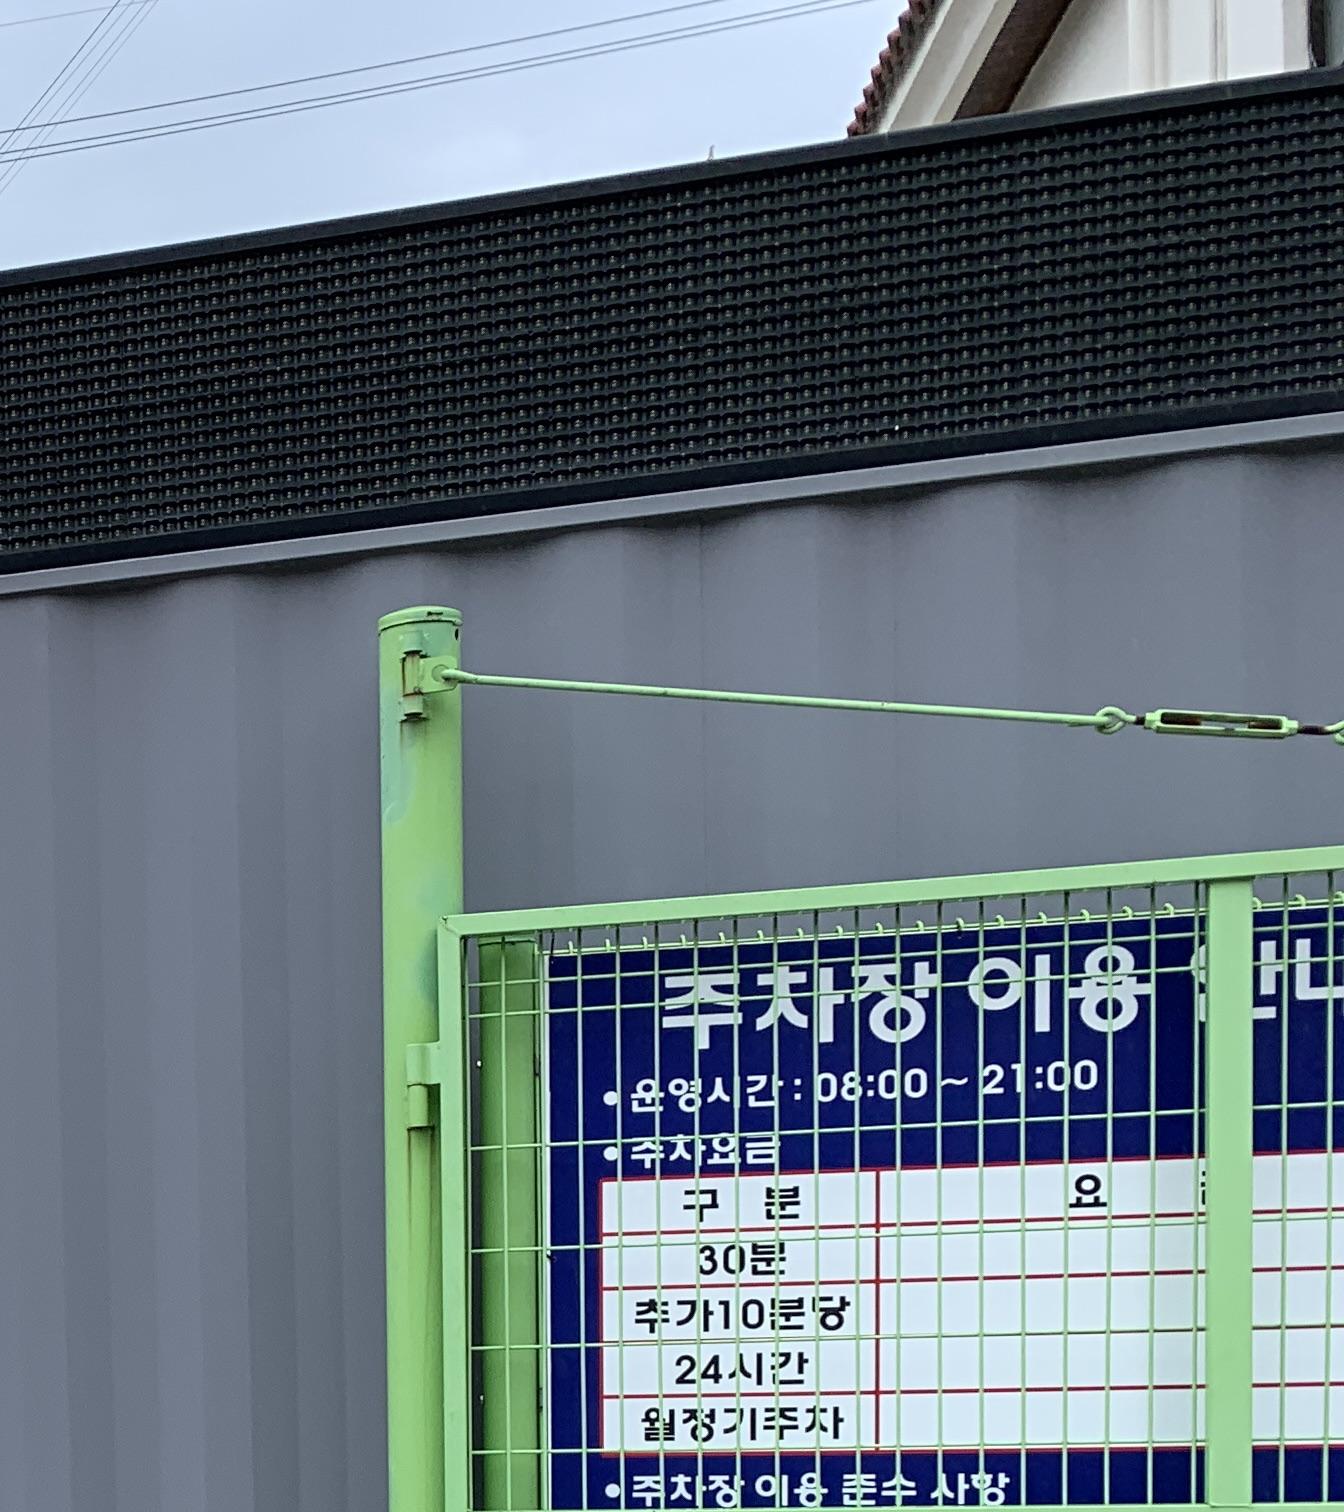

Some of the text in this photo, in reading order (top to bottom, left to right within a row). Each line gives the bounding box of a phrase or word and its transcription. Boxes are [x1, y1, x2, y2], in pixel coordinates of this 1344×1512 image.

[662, 961, 939, 1050] 주차장
[968, 944, 1153, 1032] 이용
[630, 1074, 784, 1113] 운영시간
[816, 1067, 928, 1102] 08:00
[982, 1059, 1099, 1095] 21:00
[630, 1132, 781, 1169] 주차요금
[698, 1241, 787, 1276] 30분
[634, 1295, 851, 1334] 추가10분당
[675, 1351, 809, 1386] 24시간
[641, 1405, 845, 1443] 월정기주차
[631, 1471, 1011, 1509] 주차장 이용 준수 사항
